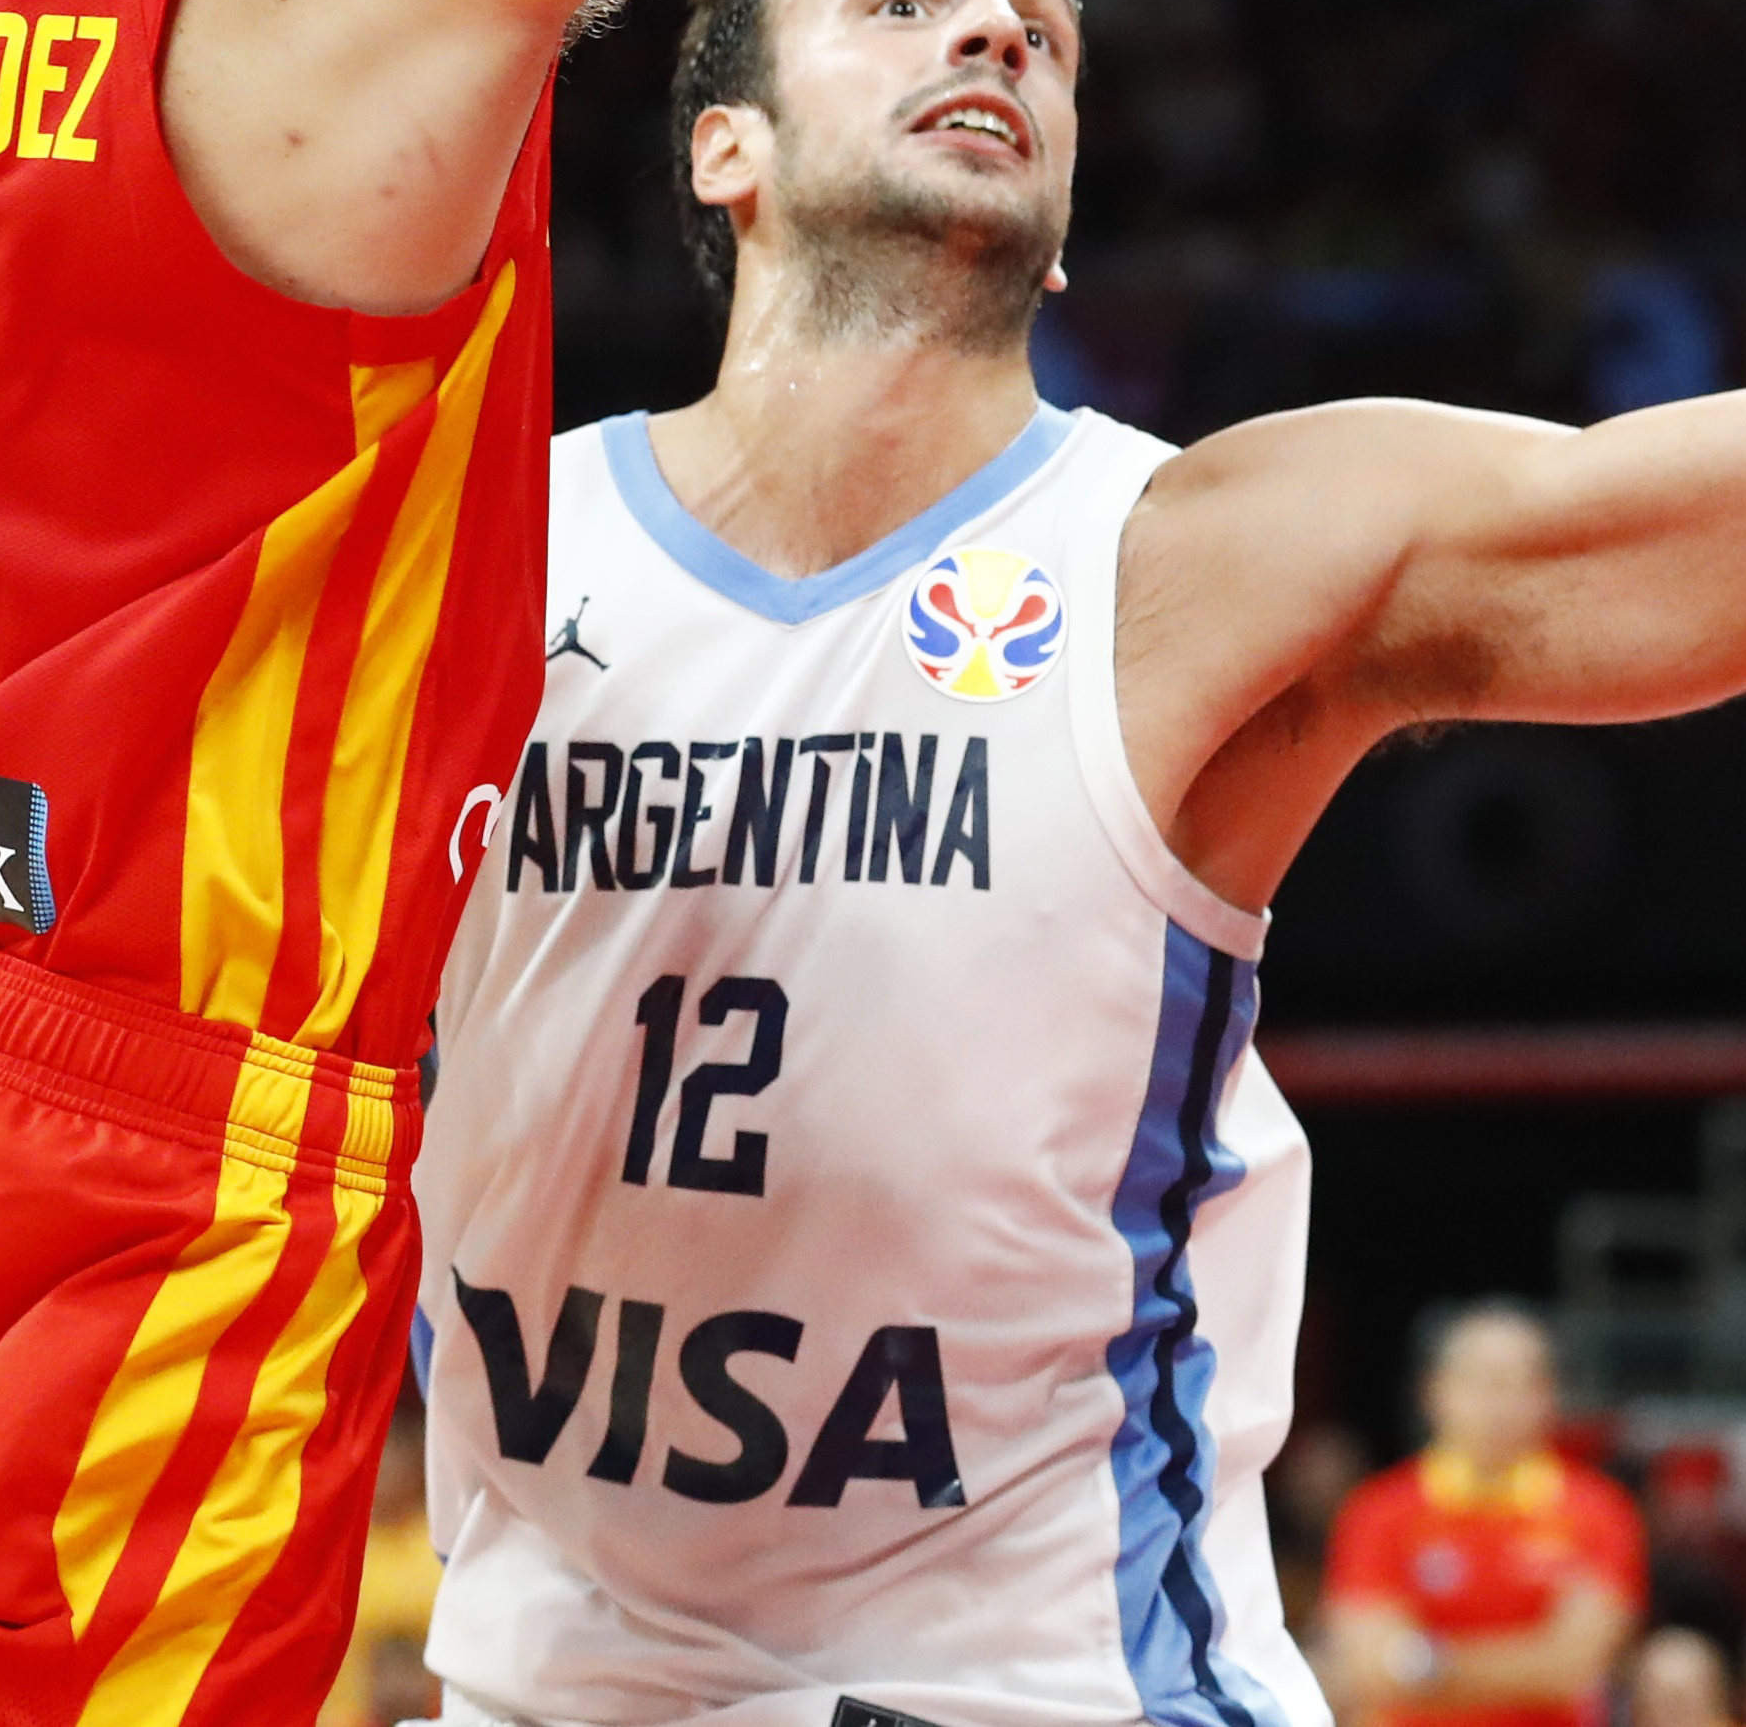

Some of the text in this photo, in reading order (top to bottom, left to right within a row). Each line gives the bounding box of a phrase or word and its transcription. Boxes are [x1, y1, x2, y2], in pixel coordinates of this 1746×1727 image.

[506, 732, 991, 893] ARGENTINA
[621, 974, 789, 1198] 12
[450, 1262, 969, 1509] VISA
